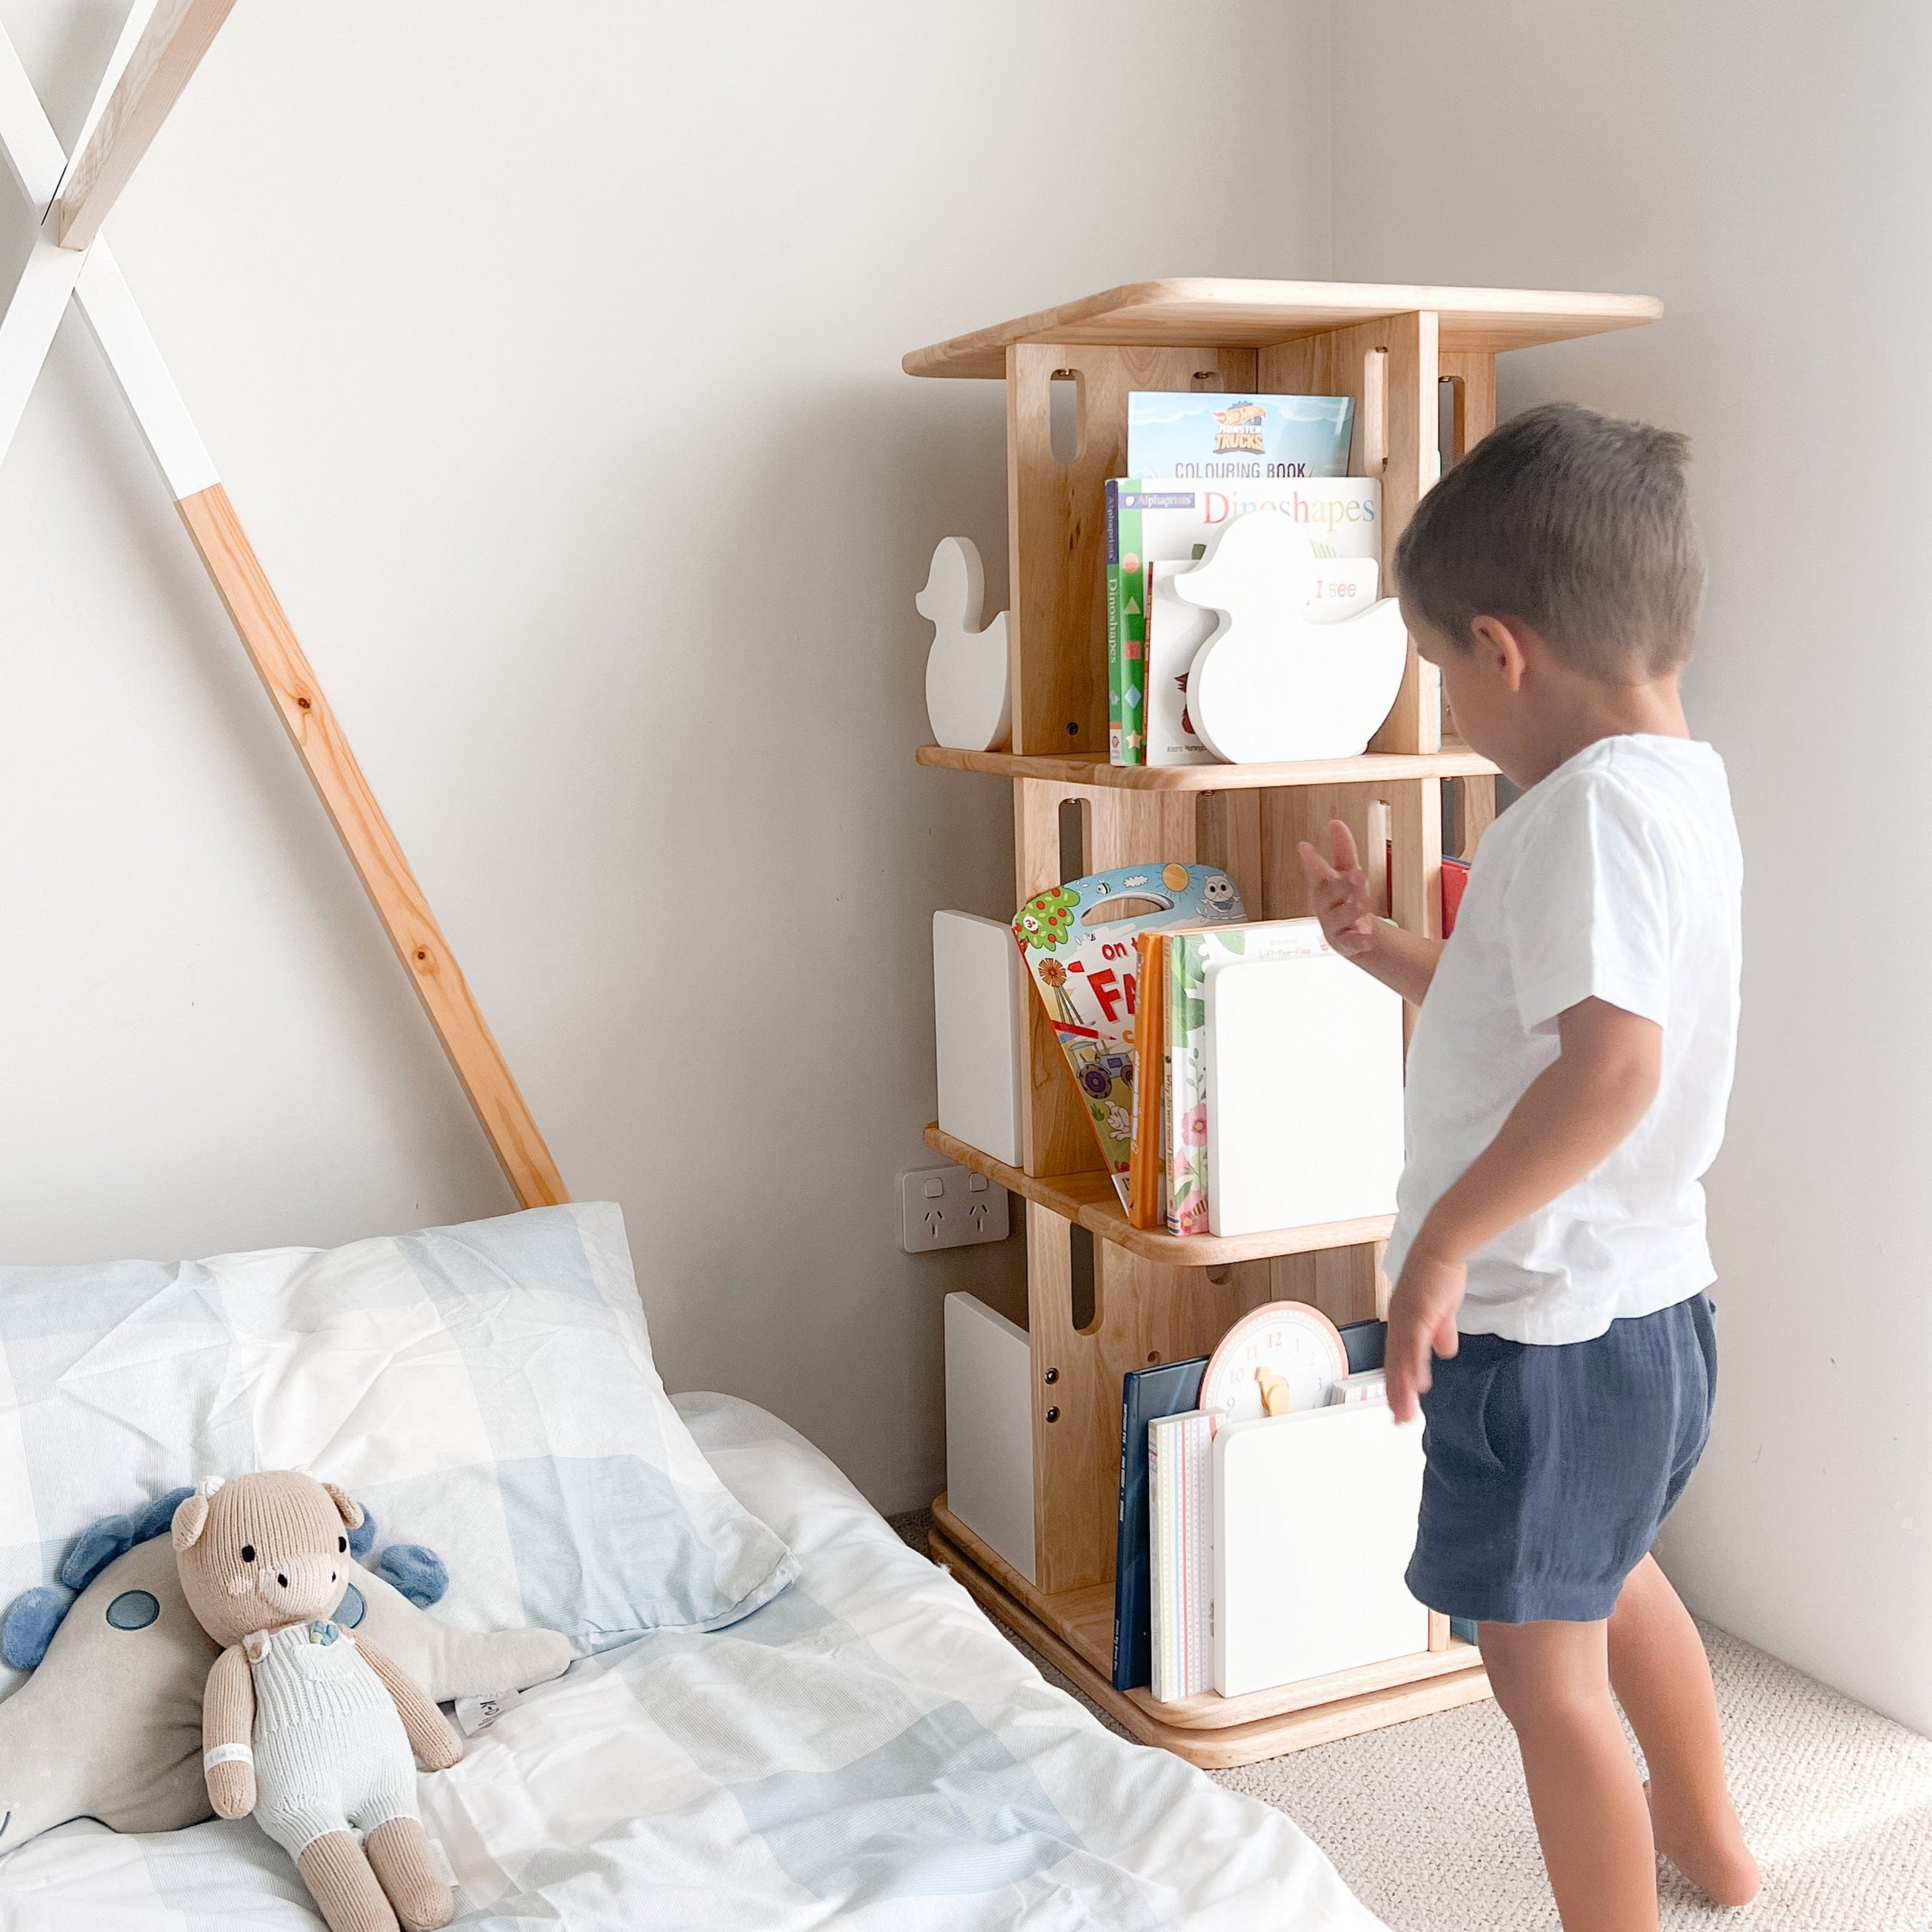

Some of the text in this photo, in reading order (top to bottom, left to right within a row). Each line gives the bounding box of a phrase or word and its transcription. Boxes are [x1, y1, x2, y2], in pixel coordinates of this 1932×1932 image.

[1219, 425, 1262, 433] MONSTER
[1215, 433, 1263, 451] TRUCKS
[1175, 462, 1306, 478] COLOURING BOOK
[1316, 580, 1356, 599] I see
[1108, 579, 1118, 663] Dinoshapes
[1026, 919, 1036, 928] 3+
[1102, 942, 1127, 960] on
[1268, 1332, 1282, 1348] 12
[1247, 1345, 1258, 1360] 11
[1230, 1368, 1245, 1384] 10
[1316, 1377, 1322, 1393] 3
[1227, 1396, 1235, 1412] 9
